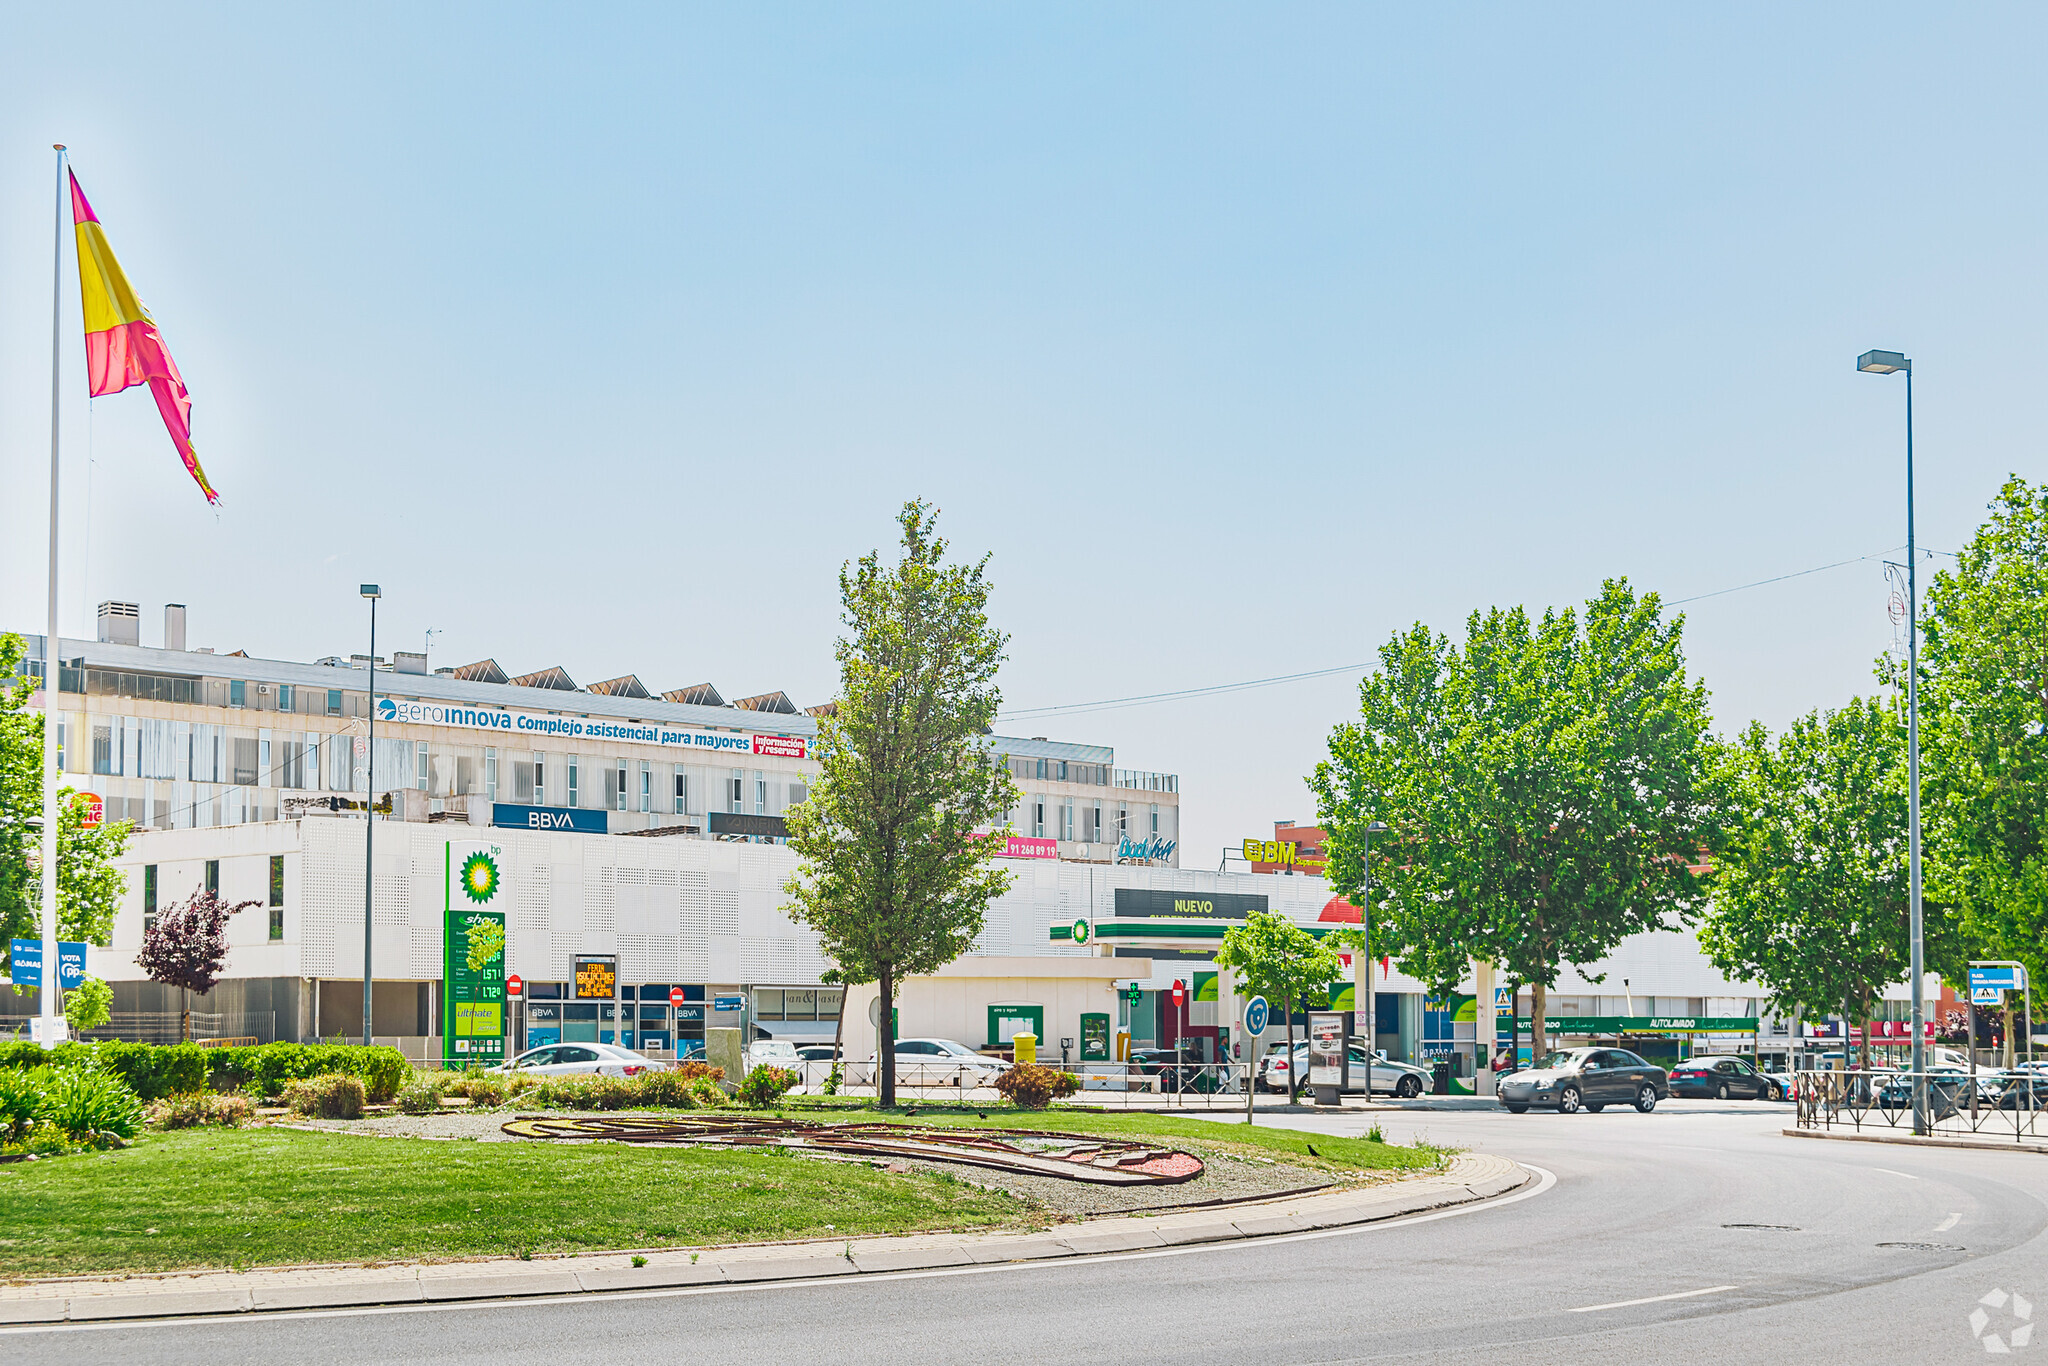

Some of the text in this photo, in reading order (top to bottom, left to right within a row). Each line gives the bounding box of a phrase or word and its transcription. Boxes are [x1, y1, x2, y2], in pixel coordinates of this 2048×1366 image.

[517, 716, 582, 736] Complejo
[585, 722, 658, 742] asistencial
[662, 731, 691, 745] para
[694, 734, 750, 751] mayores
[755, 736, 803, 749] Información
[758, 745, 764, 754] y
[764, 746, 800, 756] reservas
[529, 812, 574, 828] BBVA
[491, 845, 501, 856] bp
[1010, 844, 1019, 854] 91
[1021, 844, 1035, 855] 268
[1036, 845, 1045, 856] 89
[1046, 846, 1056, 856] 19
[1264, 841, 1296, 864] BM
[1174, 899, 1213, 913] NUEVO
[61, 954, 81, 962] VOTA
[532, 1008, 553, 1016] BBVA
[678, 1009, 698, 1017] BBVA
[1650, 1019, 1696, 1028] AUTOLAVADO
